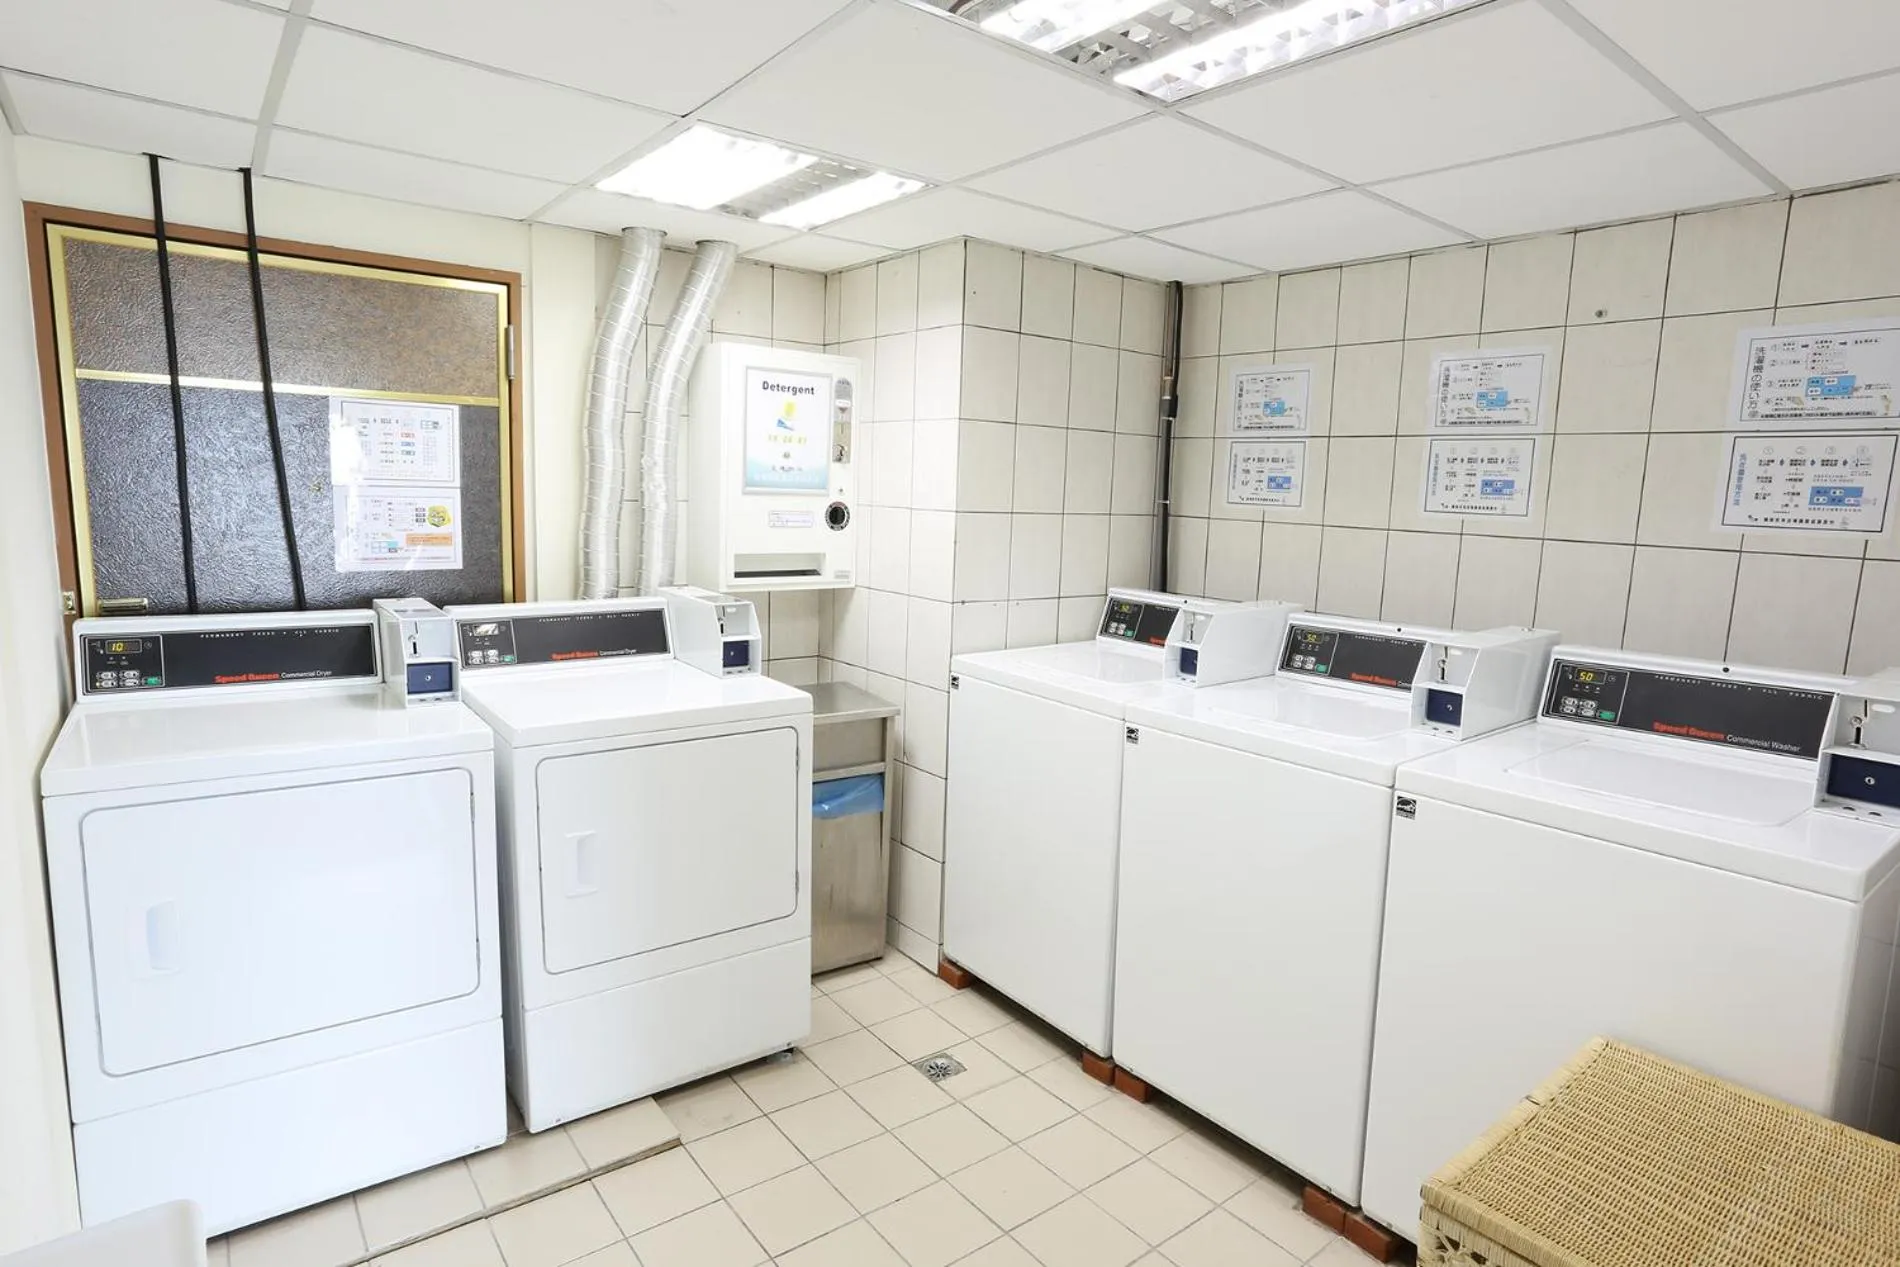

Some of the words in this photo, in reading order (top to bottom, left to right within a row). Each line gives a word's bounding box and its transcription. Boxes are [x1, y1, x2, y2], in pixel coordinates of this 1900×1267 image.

[762, 380, 816, 396] Detergent
[281, 671, 316, 679] Commercial
[316, 669, 333, 678] Dryer
[1726, 734, 1771, 749] Commercial
[1771, 740, 1802, 753] Washer
